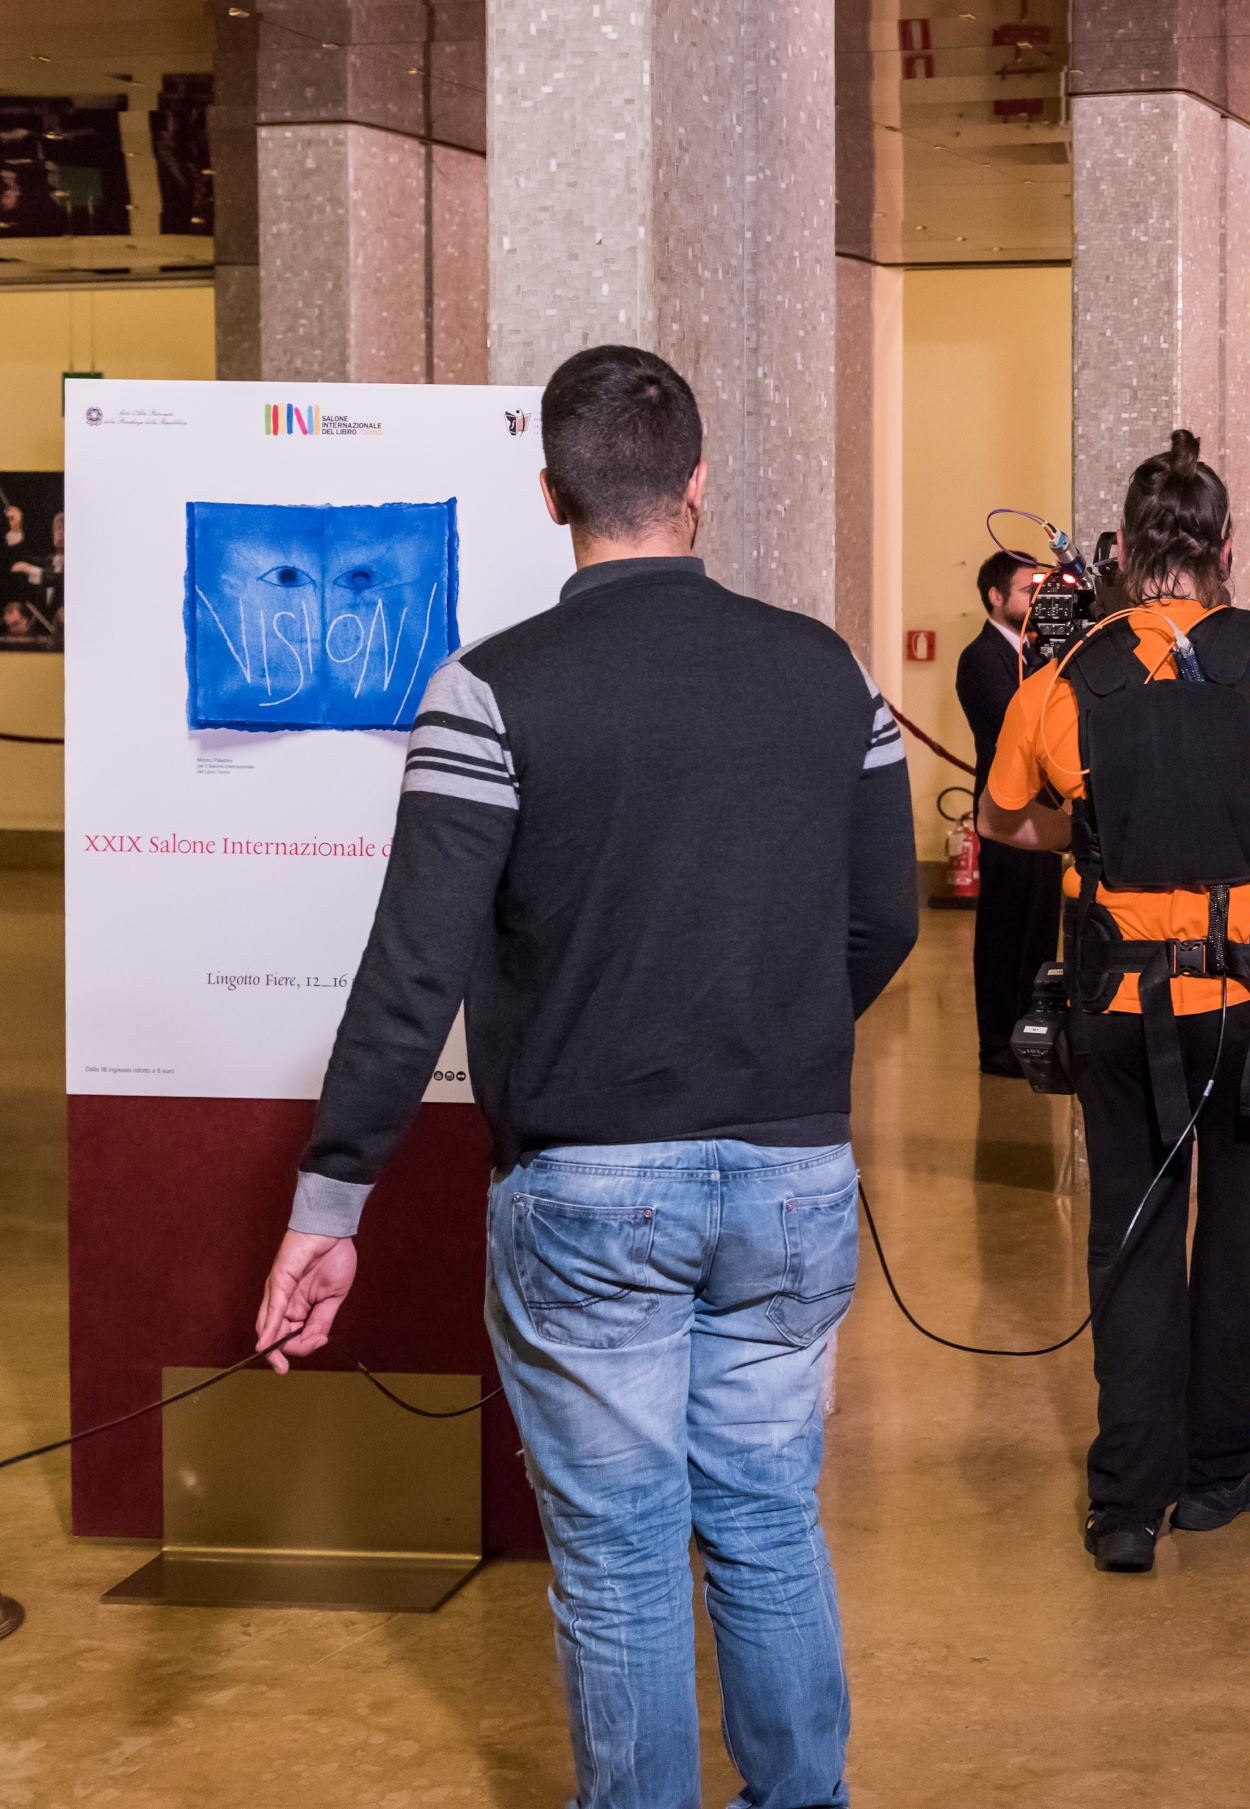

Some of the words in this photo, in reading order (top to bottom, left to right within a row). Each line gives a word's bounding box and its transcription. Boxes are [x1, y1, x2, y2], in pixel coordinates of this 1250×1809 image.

[195, 582, 438, 726] VISIONI
[84, 834, 143, 853] XXIX
[149, 832, 217, 855] Salone
[221, 834, 377, 857] Internazionale
[206, 970, 261, 991] Lingotto
[265, 971, 301, 990] Fiere,
